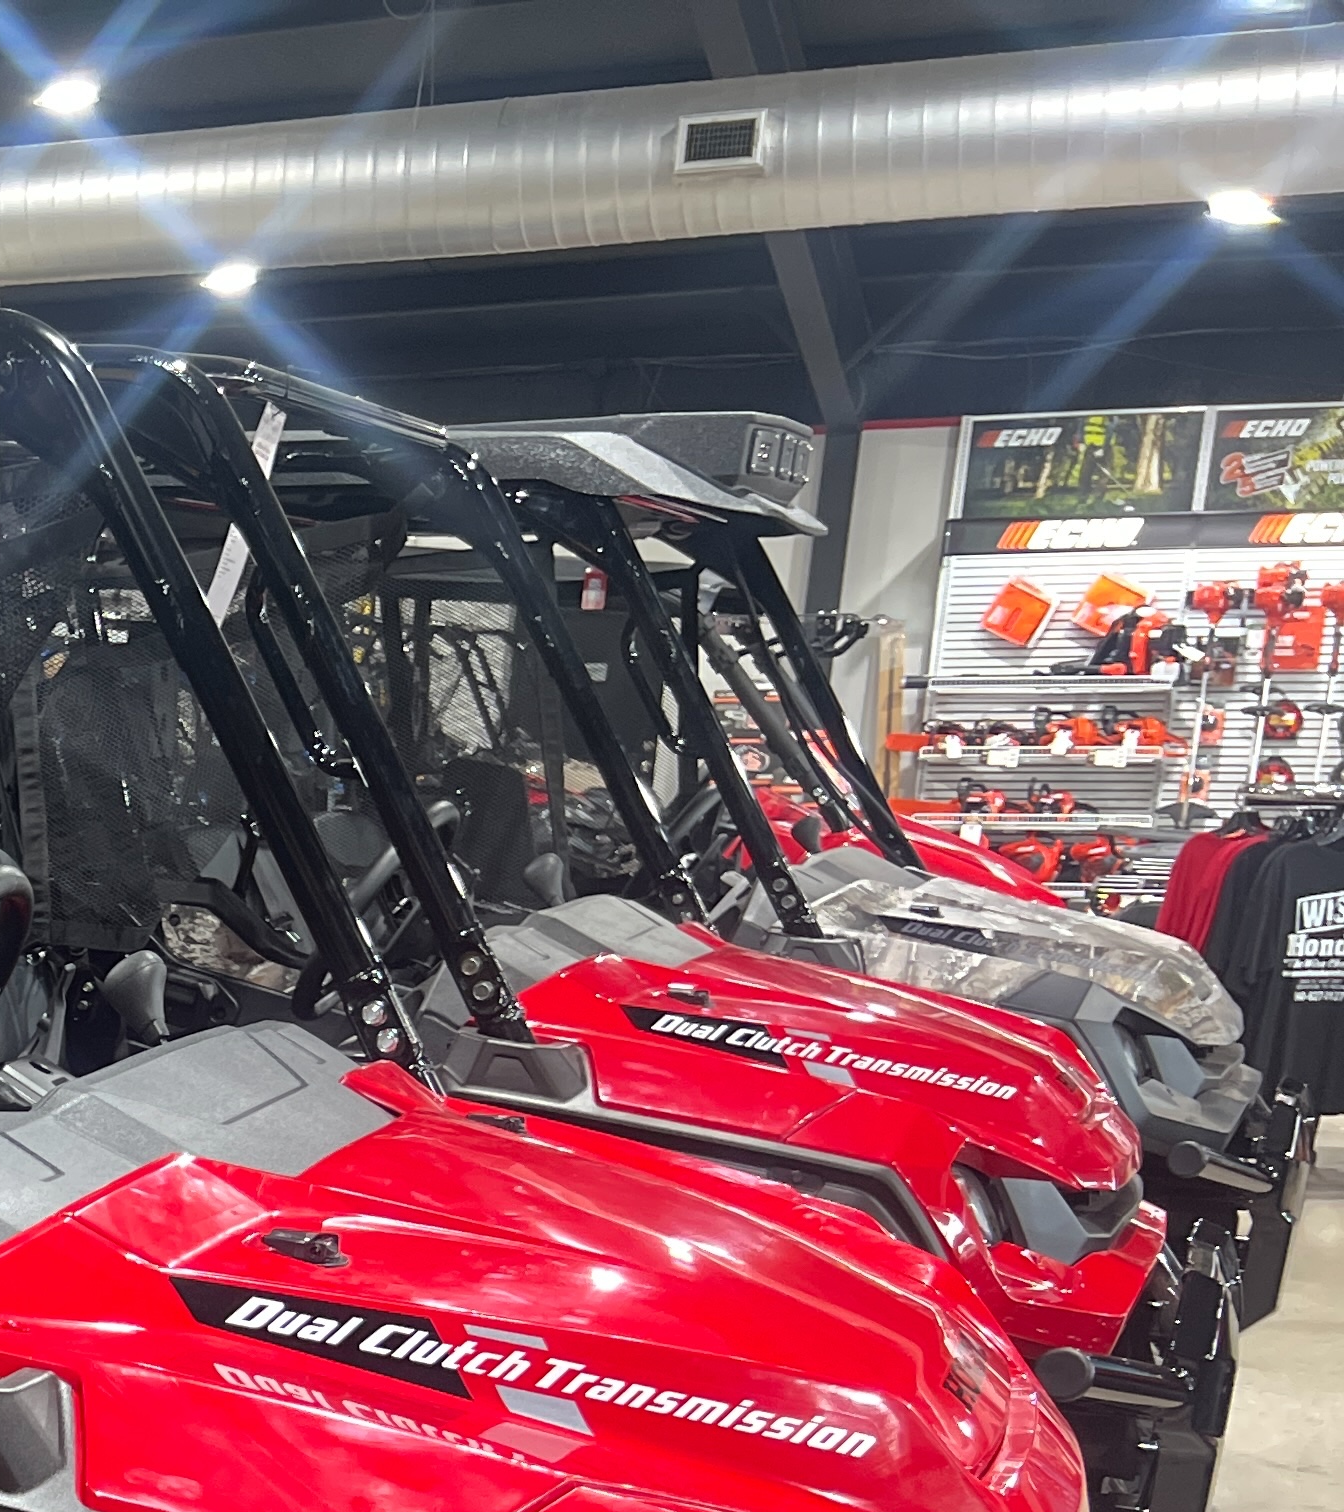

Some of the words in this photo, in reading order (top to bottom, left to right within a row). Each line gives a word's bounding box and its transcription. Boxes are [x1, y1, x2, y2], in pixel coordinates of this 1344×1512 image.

[994, 427, 1062, 447] ECHO
[1240, 418, 1310, 438] ECHO
[1026, 517, 1145, 549] ECHO
[900, 921, 955, 941] Dual
[650, 1013, 732, 1043] Dual
[725, 1026, 822, 1059] Clutch
[825, 1045, 1018, 1100] Transmission
[224, 1296, 363, 1345] Dual
[359, 1324, 531, 1381] Clutch
[534, 1357, 878, 1458] Transmission
